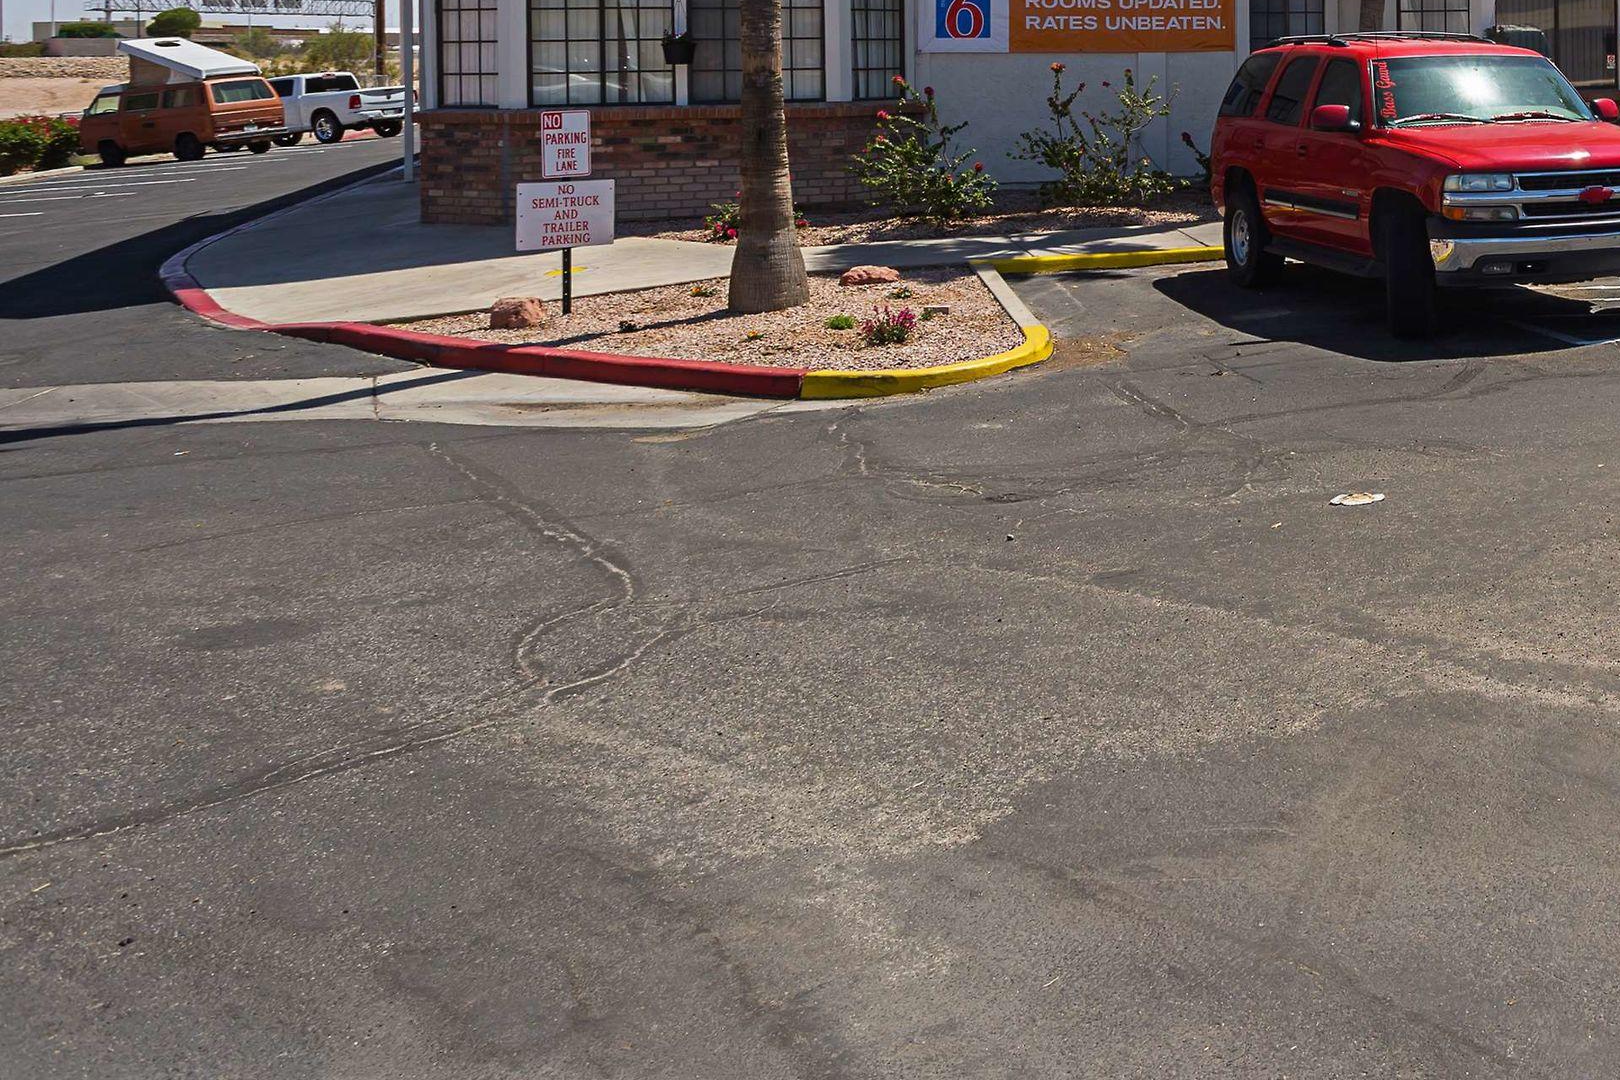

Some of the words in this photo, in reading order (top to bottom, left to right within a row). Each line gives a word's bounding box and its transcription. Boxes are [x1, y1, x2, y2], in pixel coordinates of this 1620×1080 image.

[1025, 15, 1099, 31] RATES
[1105, 16, 1227, 31] UNBEATEN.
[543, 114, 561, 129] NO
[545, 131, 587, 145] PARKING
[557, 148, 576, 159] FIRE
[556, 160, 578, 172] LANE
[558, 184, 575, 195] NO
[532, 195, 600, 209] SEMI-TRUCK
[554, 209, 578, 220] AND
[543, 221, 589, 233] TRAILER
[542, 233, 590, 246] PARKING
